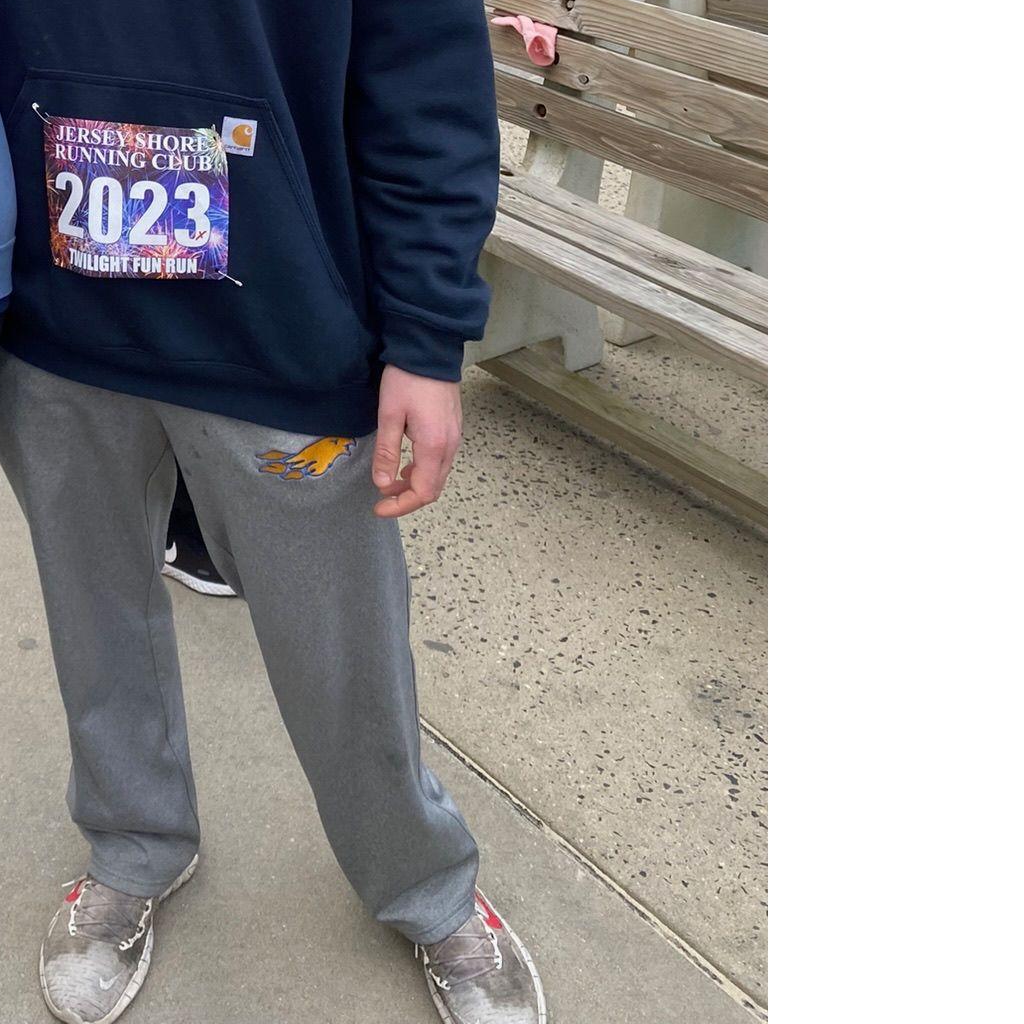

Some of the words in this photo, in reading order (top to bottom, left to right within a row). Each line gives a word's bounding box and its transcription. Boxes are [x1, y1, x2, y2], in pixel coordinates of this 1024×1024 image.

[56, 125, 127, 147] JERSEY
[135, 132, 210, 152] SHORE
[55, 144, 146, 169] RUNNING
[152, 153, 212, 172] CLUB
[55, 171, 211, 248] 2023
[69, 248, 129, 273] TWILIGHT
[133, 256, 162, 273] FUN
[166, 258, 198, 274] RUN
